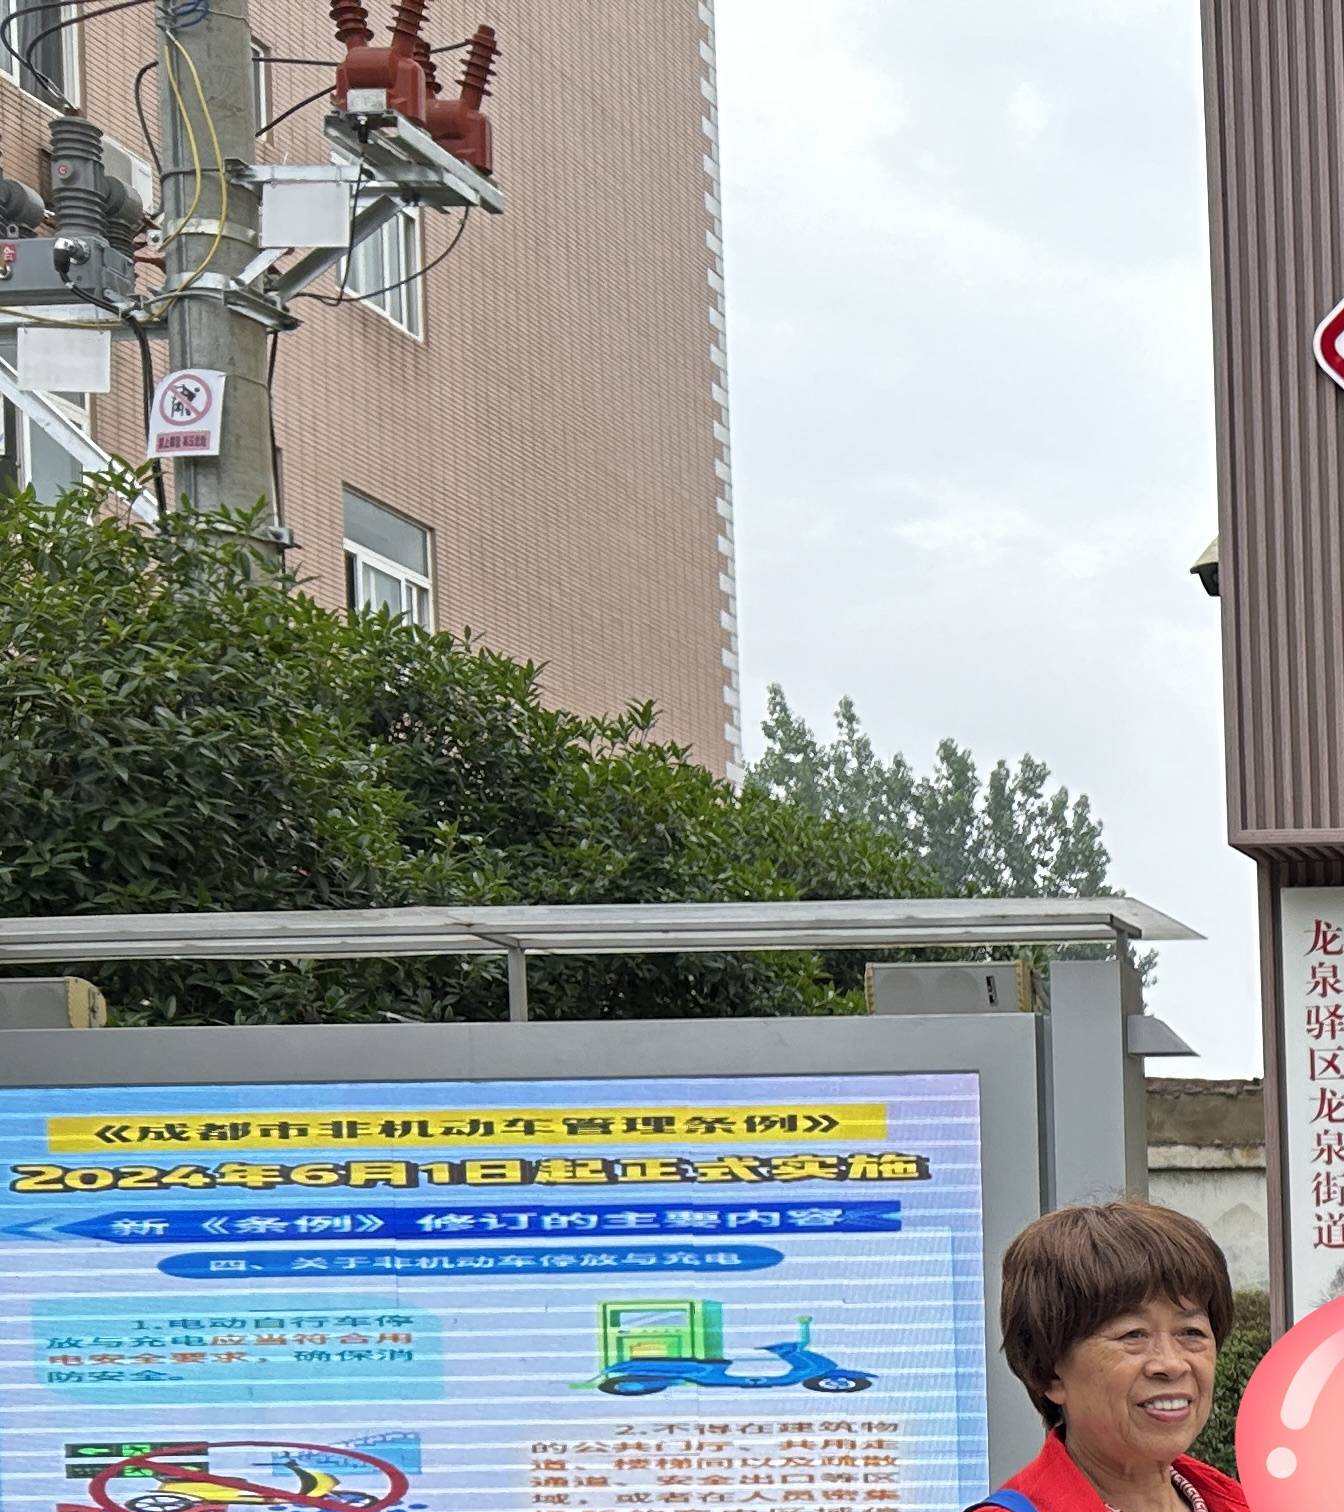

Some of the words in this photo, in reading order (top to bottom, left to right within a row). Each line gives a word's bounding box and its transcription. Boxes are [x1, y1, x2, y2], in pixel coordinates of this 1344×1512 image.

[94, 1114, 840, 1143] 《成都市非机动车管理条例》
[11, 1152, 932, 1193] 2024年6月1日起正式实施
[208, 1252, 742, 1273] 四、关于非机动车停放与充电
